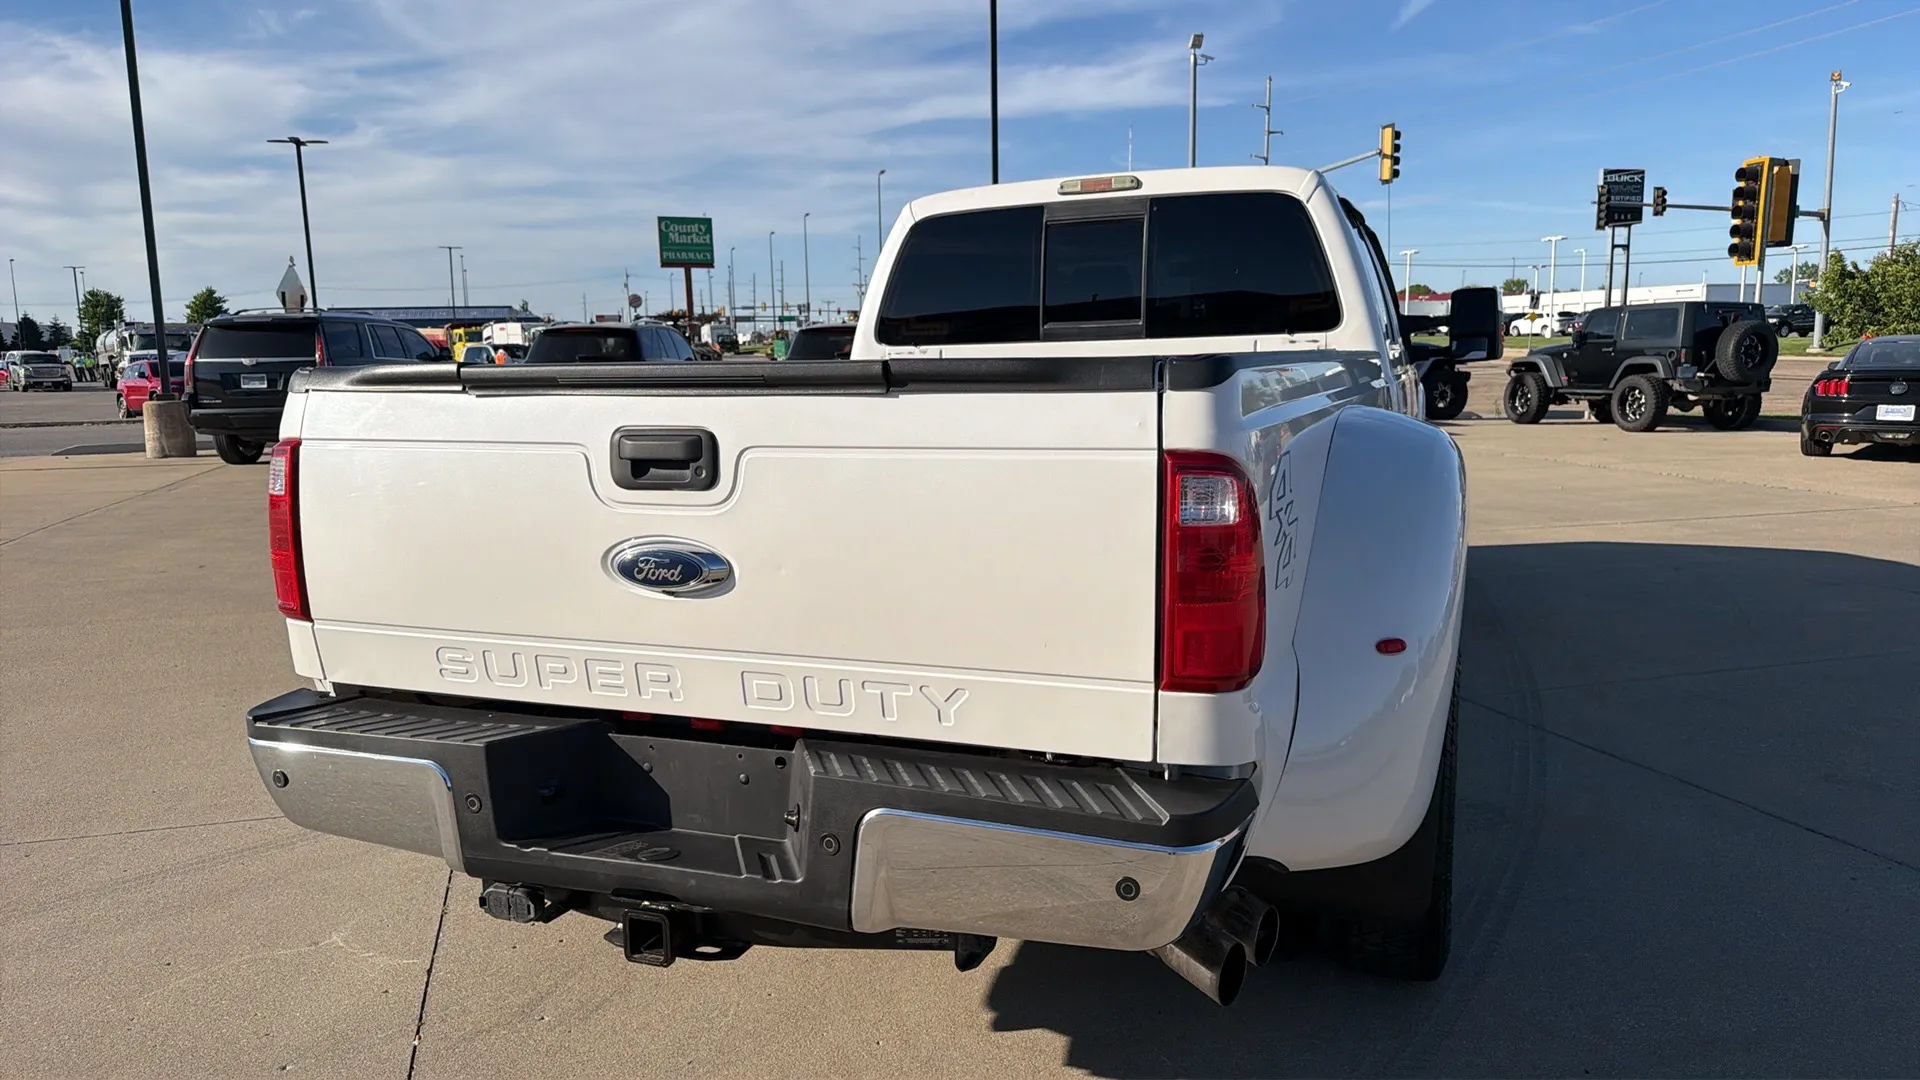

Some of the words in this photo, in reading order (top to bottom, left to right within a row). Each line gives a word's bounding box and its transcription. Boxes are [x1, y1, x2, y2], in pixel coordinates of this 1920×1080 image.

[1606, 174, 1643, 182] BUICK
[660, 220, 708, 235] County
[668, 232, 711, 244] Market
[662, 251, 713, 260] PHARMACY
[633, 556, 683, 581] Ford
[435, 645, 685, 703] SUPER
[740, 669, 970, 728] DUTY
